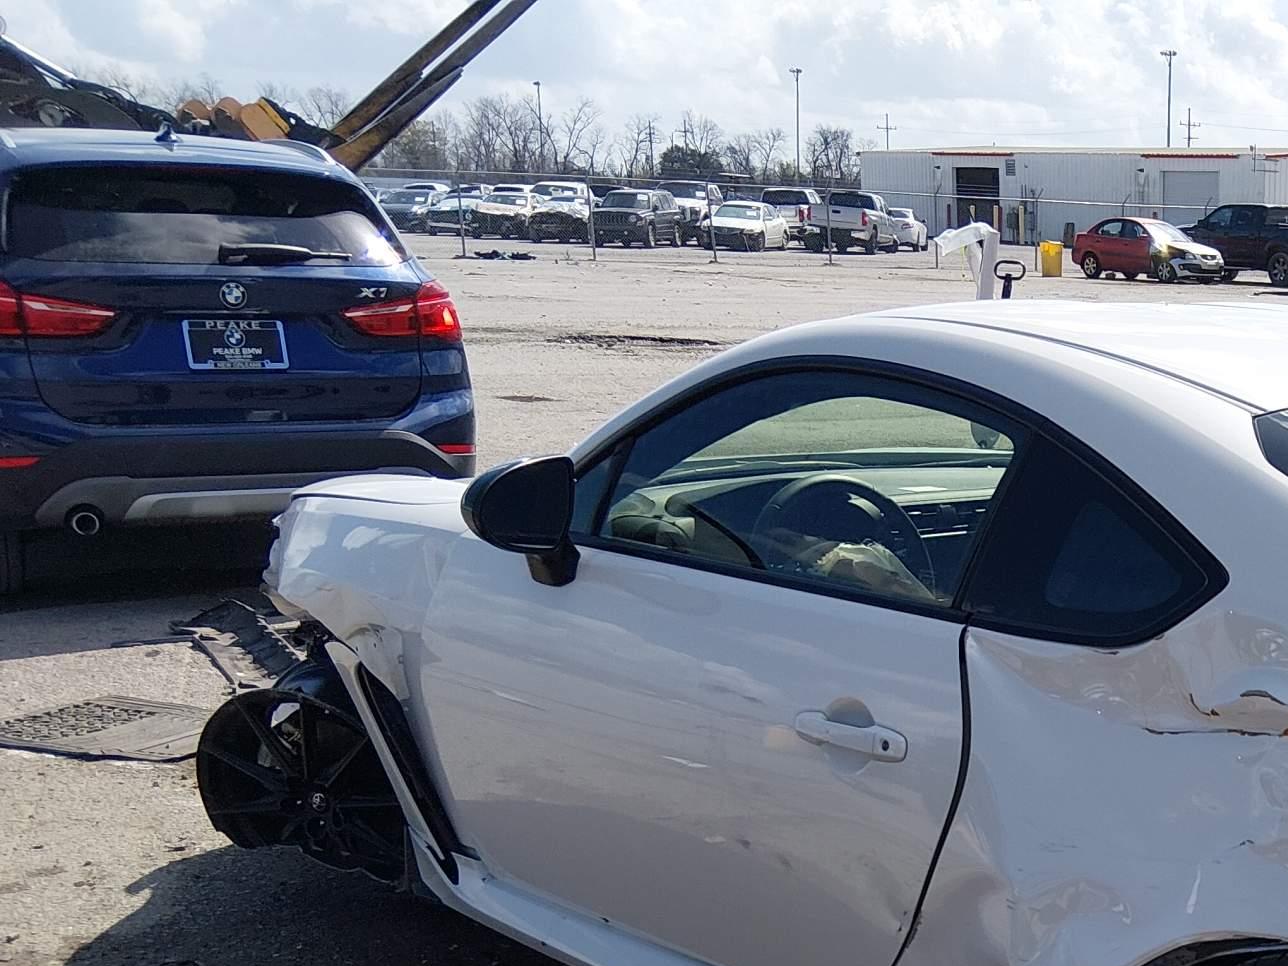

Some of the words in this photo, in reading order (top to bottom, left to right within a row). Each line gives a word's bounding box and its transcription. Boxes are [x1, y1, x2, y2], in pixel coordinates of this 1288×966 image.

[205, 320, 261, 330] PEAKE
[212, 347, 241, 355] PEAKE
[241, 347, 263, 355] BMW
